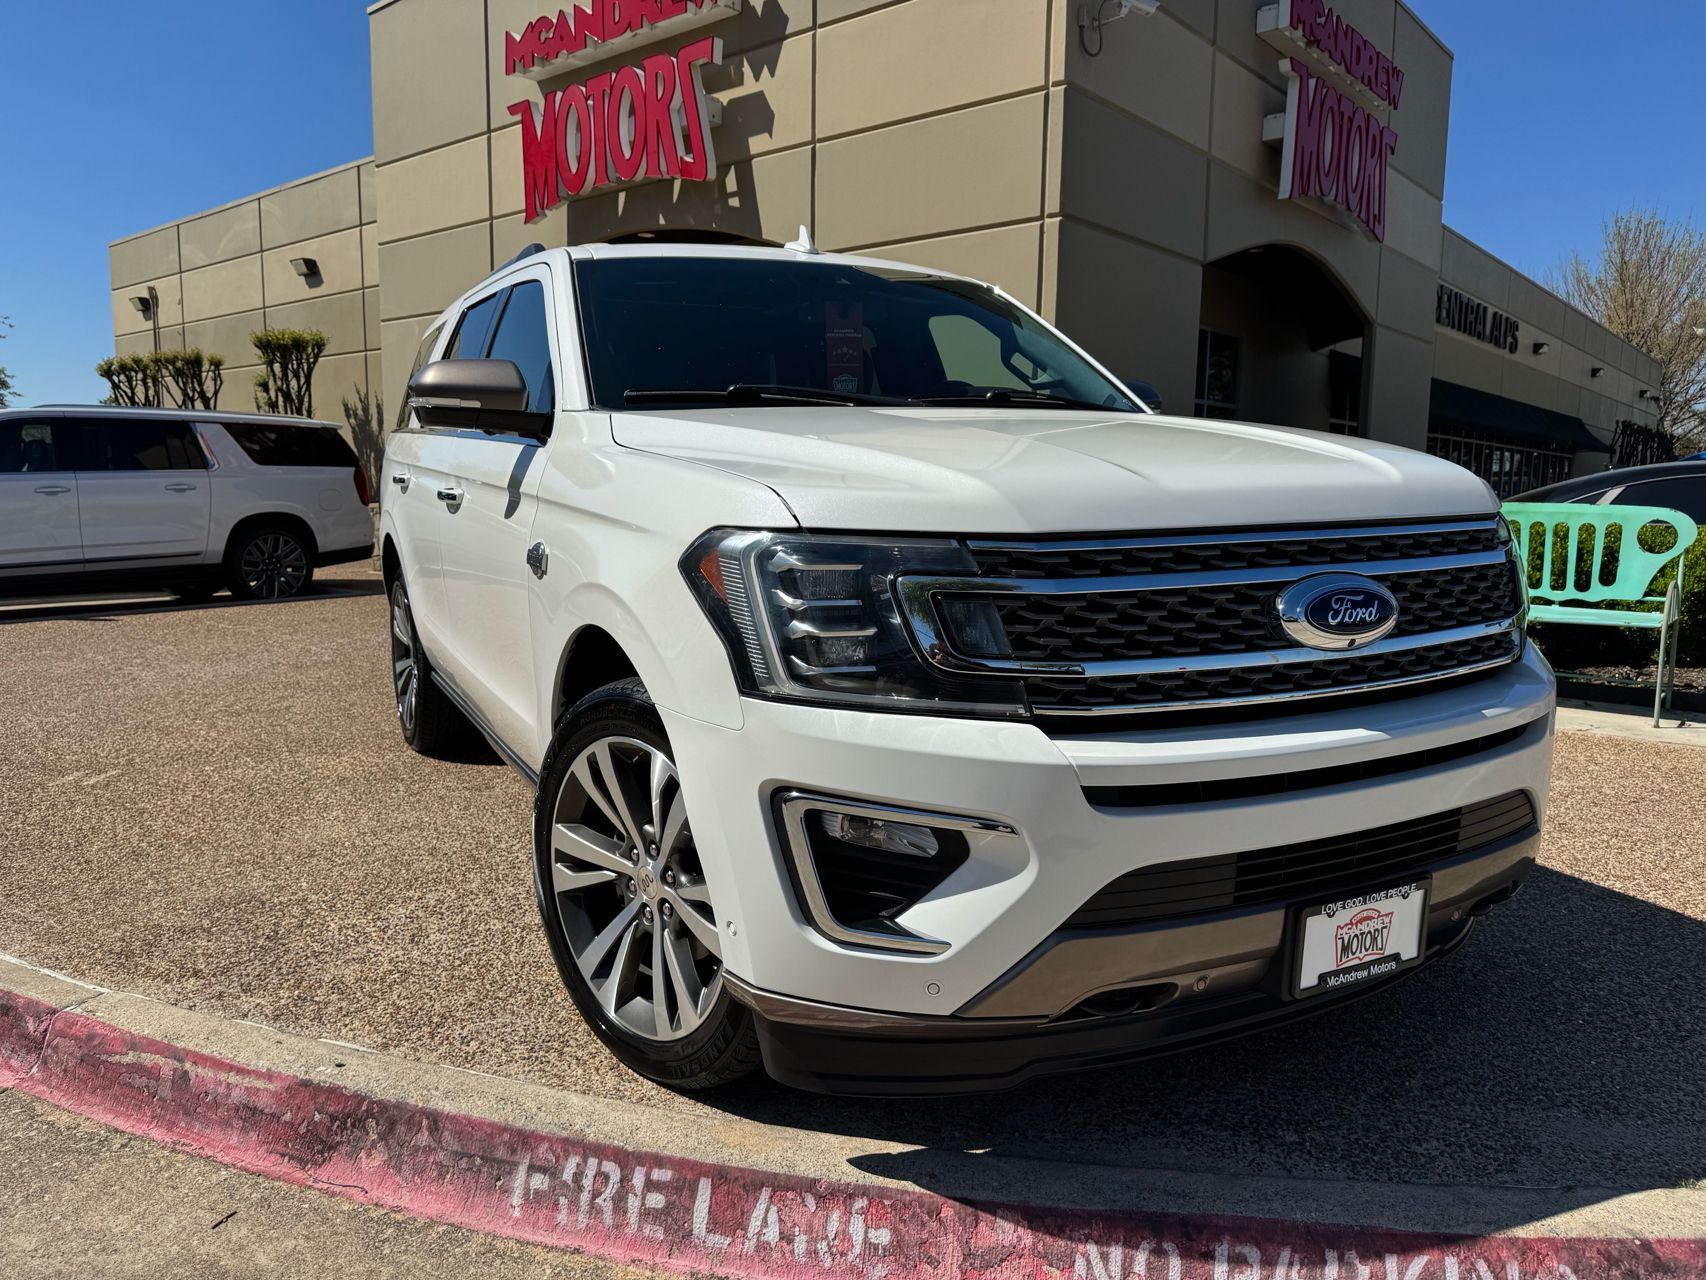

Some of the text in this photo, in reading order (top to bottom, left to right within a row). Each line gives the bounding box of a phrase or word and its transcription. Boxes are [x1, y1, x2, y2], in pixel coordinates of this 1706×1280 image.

[506, 36, 716, 224] MOTORS
[1289, 56, 1398, 243] MOTORS
[1328, 594, 1379, 625] Ford
[1321, 883, 1418, 914] LOVE GOD. LOVE PEOPLE.
[1338, 926, 1388, 962] MOTORS
[1327, 961, 1396, 987] McAndrew Motors
[511, 1154, 673, 1240] FIRE
